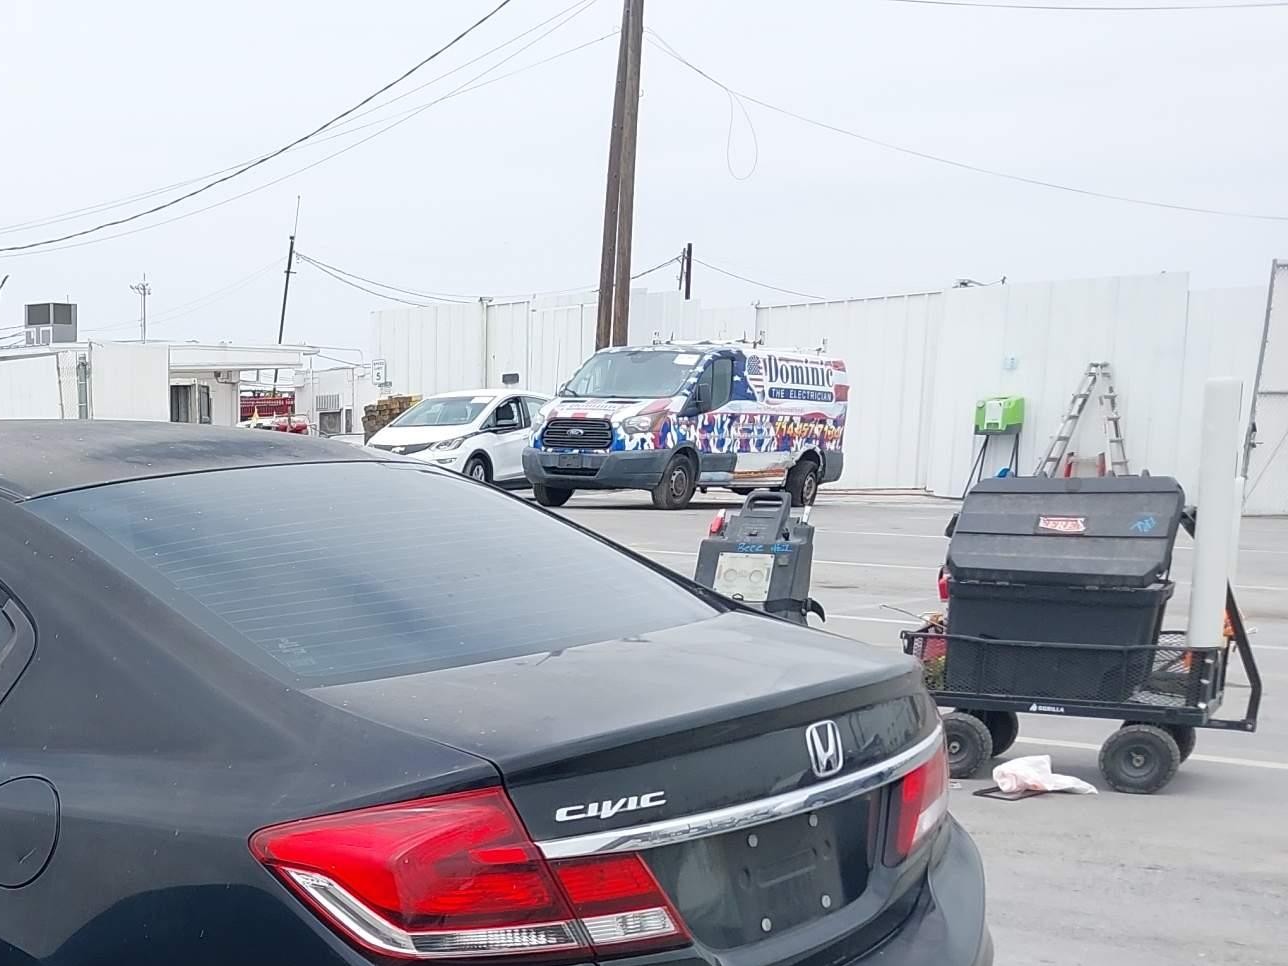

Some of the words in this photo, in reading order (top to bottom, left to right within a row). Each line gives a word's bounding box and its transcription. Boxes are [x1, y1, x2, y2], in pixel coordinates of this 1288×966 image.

[375, 371, 382, 381] 5
[767, 354, 833, 388] Dominic
[771, 388, 785, 398] THE
[789, 389, 832, 401] ELECTRICIAN
[555, 790, 667, 822] CIVIC
